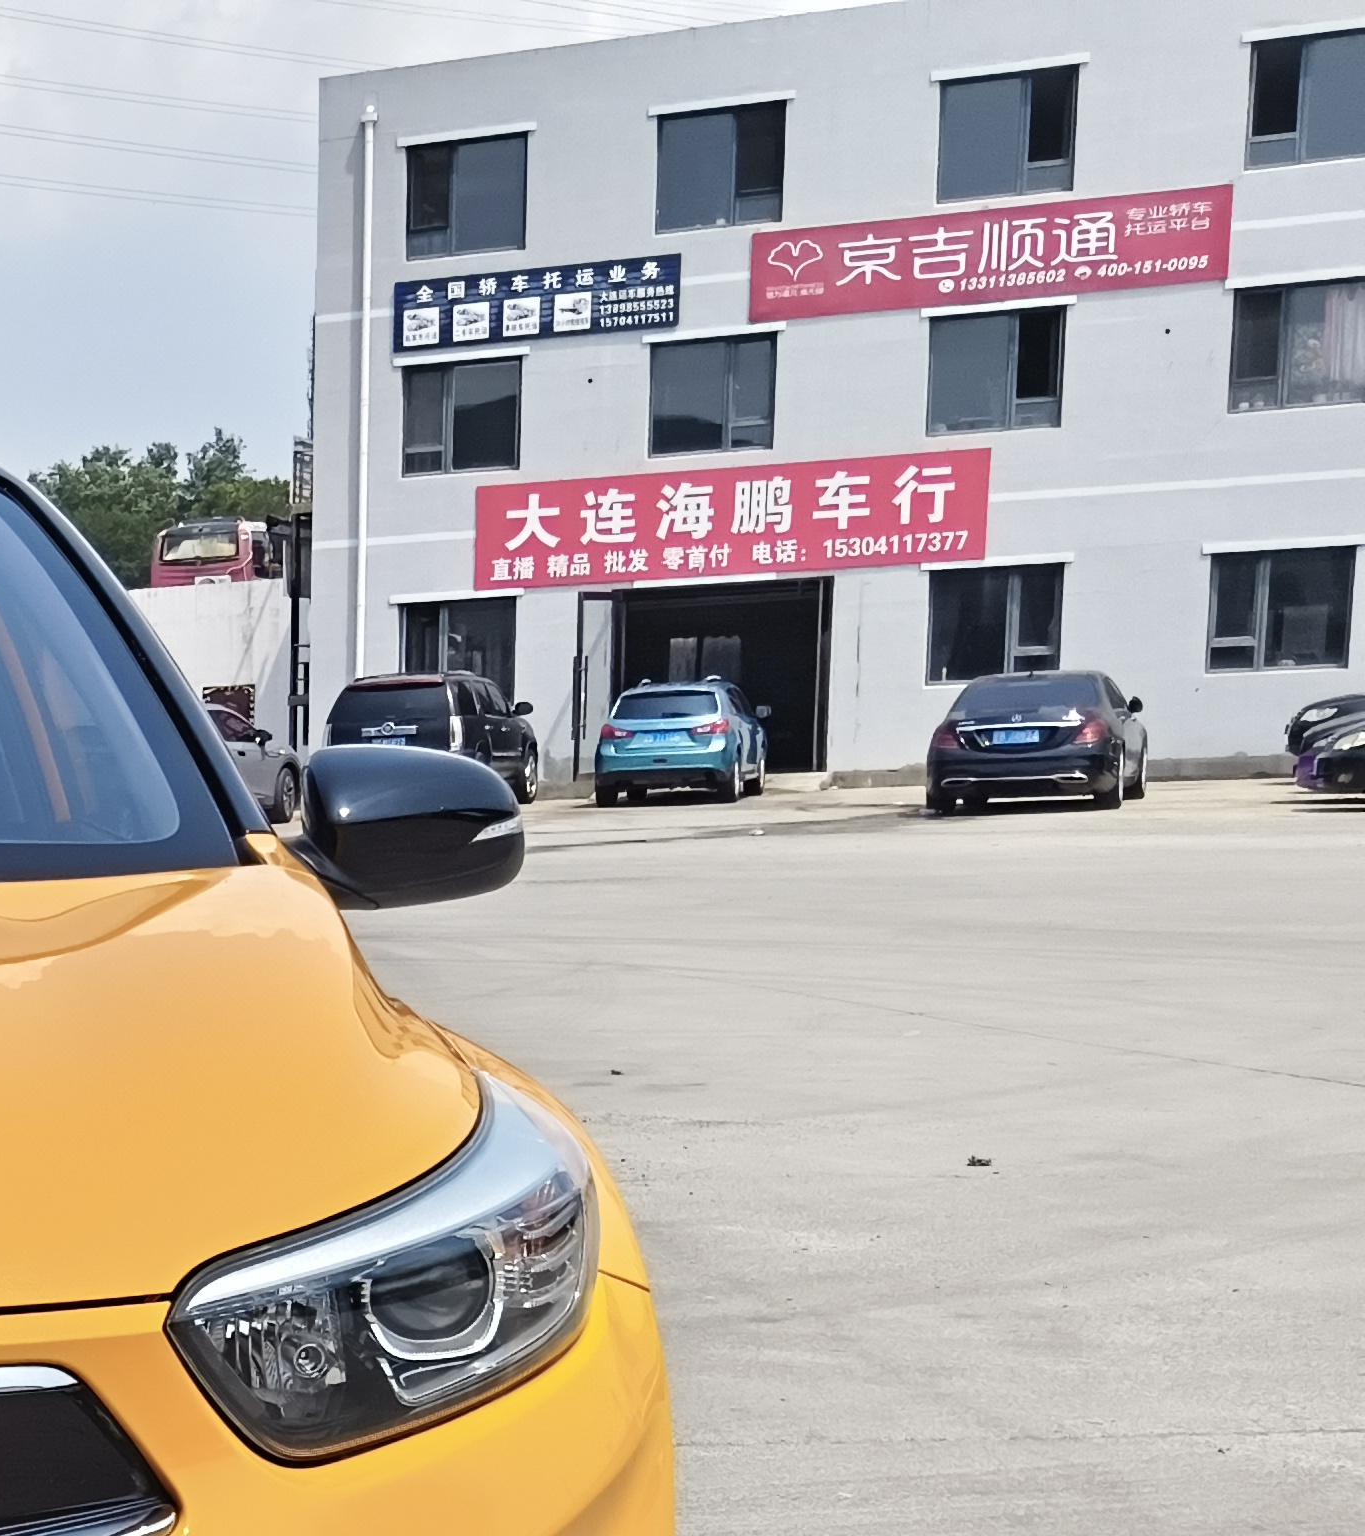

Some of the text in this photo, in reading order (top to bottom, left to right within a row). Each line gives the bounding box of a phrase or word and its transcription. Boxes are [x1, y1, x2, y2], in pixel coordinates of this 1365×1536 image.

[1124, 217, 1210, 238] 托运平台
[1126, 201, 1213, 220] 专业轿车
[836, 211, 1118, 286] 京吉顺通
[416, 261, 660, 303] 全国轿车托运业务
[959, 255, 1209, 292] 13311385602 400-151-0095
[600, 311, 674, 328] 15704117511
[504, 464, 957, 551] 大连海鹏车行
[490, 556, 535, 582] 直播
[546, 553, 591, 578] 精品
[603, 549, 649, 574] 批发
[661, 543, 733, 573] 零首付
[822, 530, 969, 559] 15304117377
